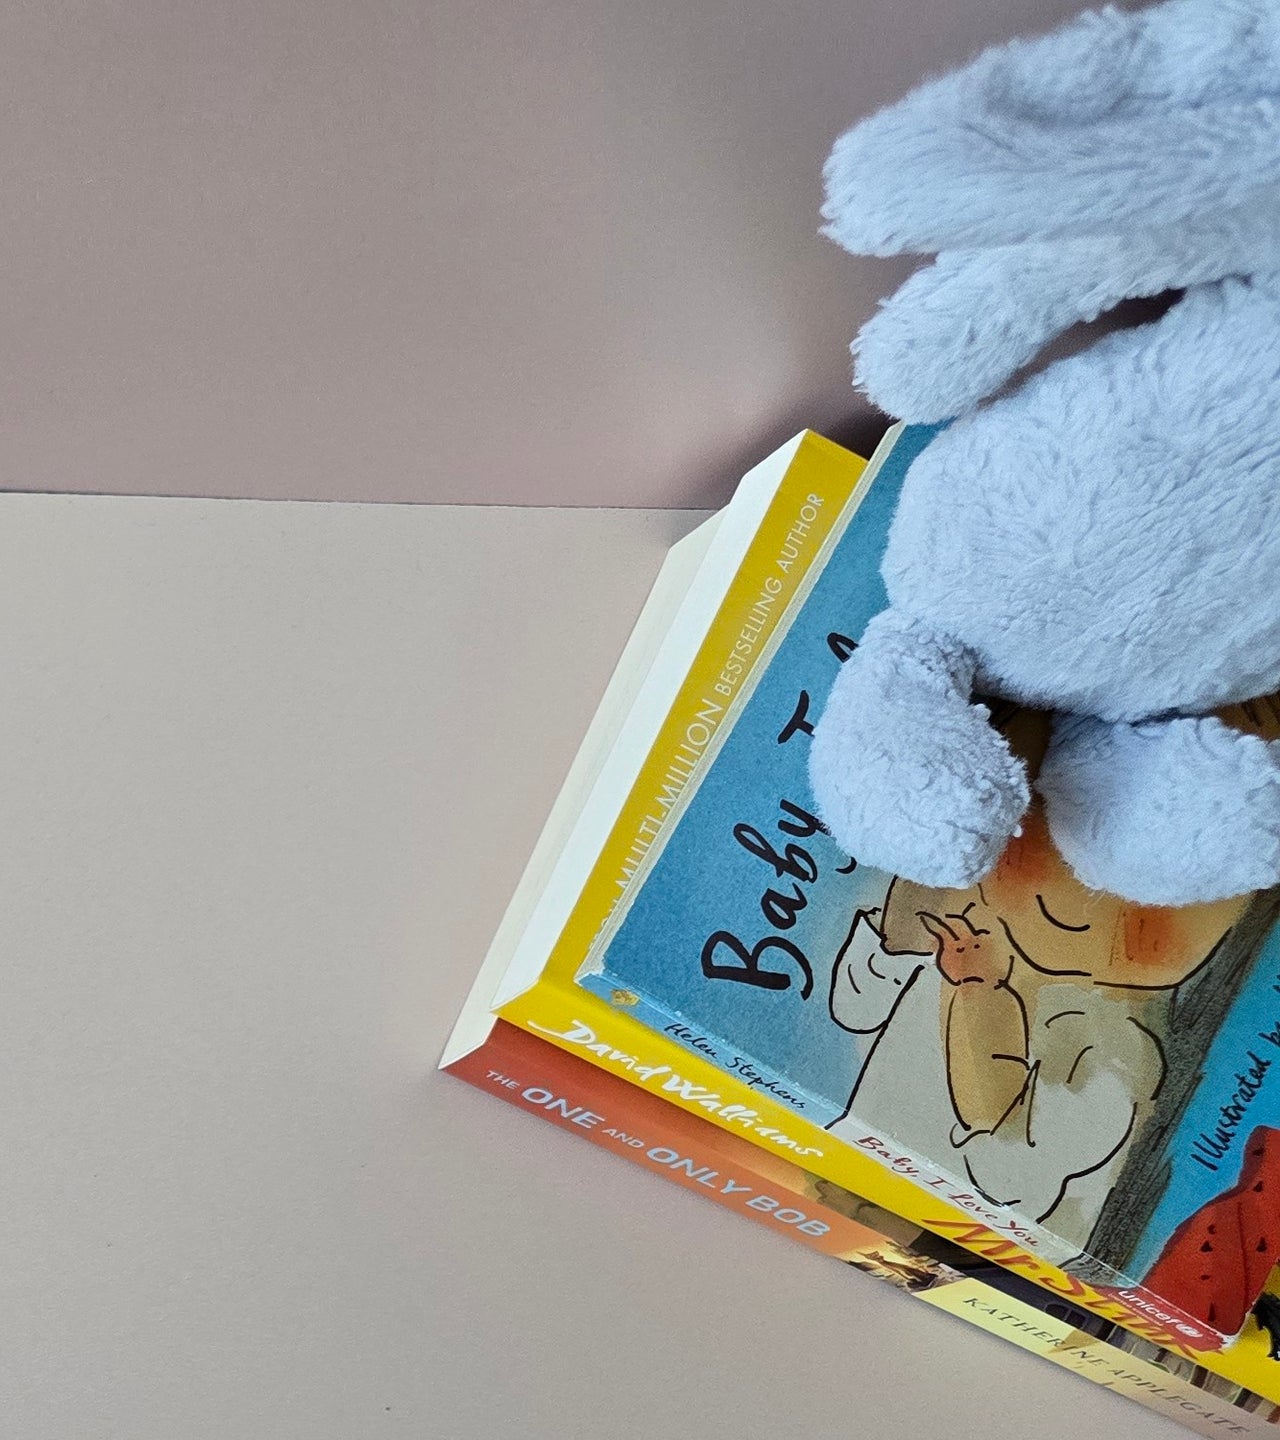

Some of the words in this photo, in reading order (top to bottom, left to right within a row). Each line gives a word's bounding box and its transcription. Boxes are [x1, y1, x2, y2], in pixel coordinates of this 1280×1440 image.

[714, 577, 783, 696] BESTSELLING
[775, 492, 825, 574] AUTHOR
[527, 1019, 674, 1082] David
[661, 1074, 824, 1158] Walliams
[663, 1022, 718, 1060] Helen
[724, 1056, 806, 1110] Stephens
[1190, 1050, 1272, 1172] Illustrated
[485, 1070, 521, 1091] THE
[521, 1086, 607, 1130] ONE
[601, 1127, 647, 1150] AND
[646, 1146, 753, 1196] ONLY
[745, 1194, 832, 1237] BOB
[852, 1136, 920, 1178] Baby,
[923, 1175, 955, 1190] I
[947, 1193, 999, 1221] Love
[992, 1219, 1040, 1247] You
[921, 1218, 1041, 1270] Mr
[963, 1297, 1110, 1368] KATHERINE
[1107, 1367, 1251, 1435] APPLEGATE
[1118, 1290, 1184, 1325] unicef
